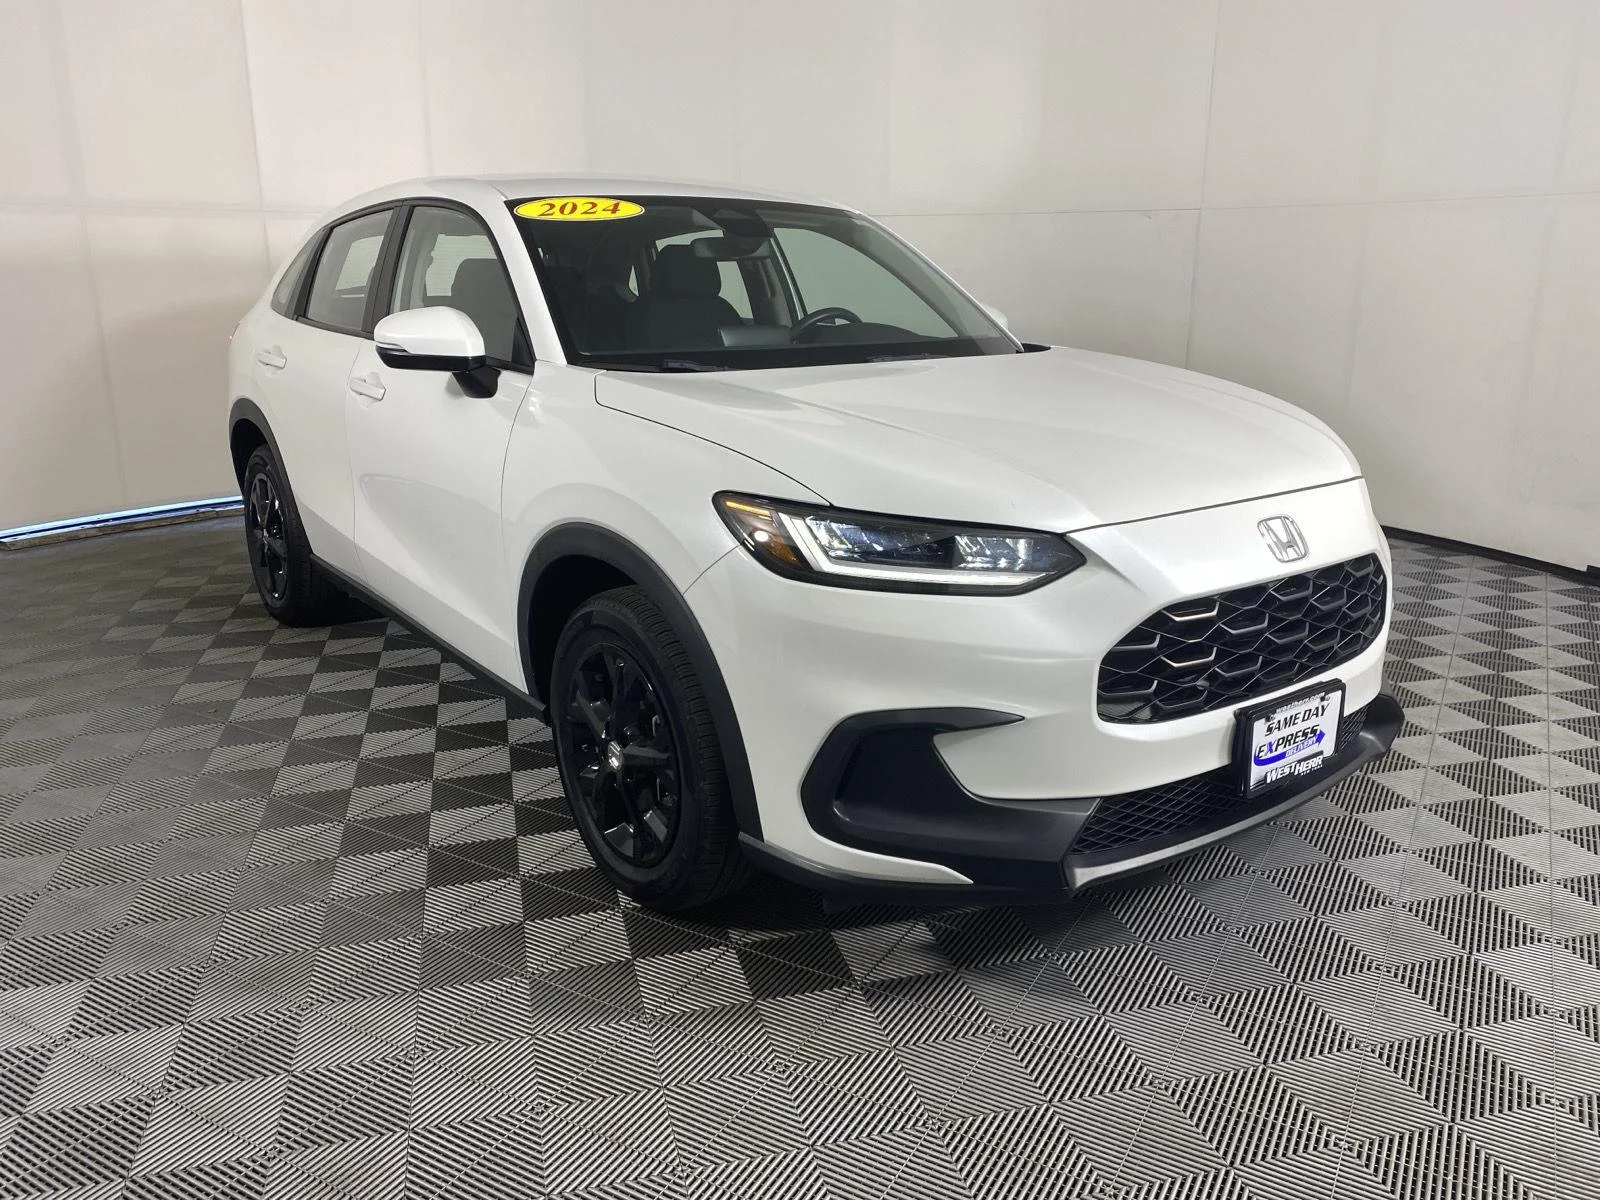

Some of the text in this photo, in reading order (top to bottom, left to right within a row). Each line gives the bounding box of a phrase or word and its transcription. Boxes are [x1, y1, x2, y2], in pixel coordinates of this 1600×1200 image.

[537, 201, 621, 217] 2024
[1265, 703, 1330, 737] SAME DAY
[1257, 724, 1320, 758] EXPRESS
